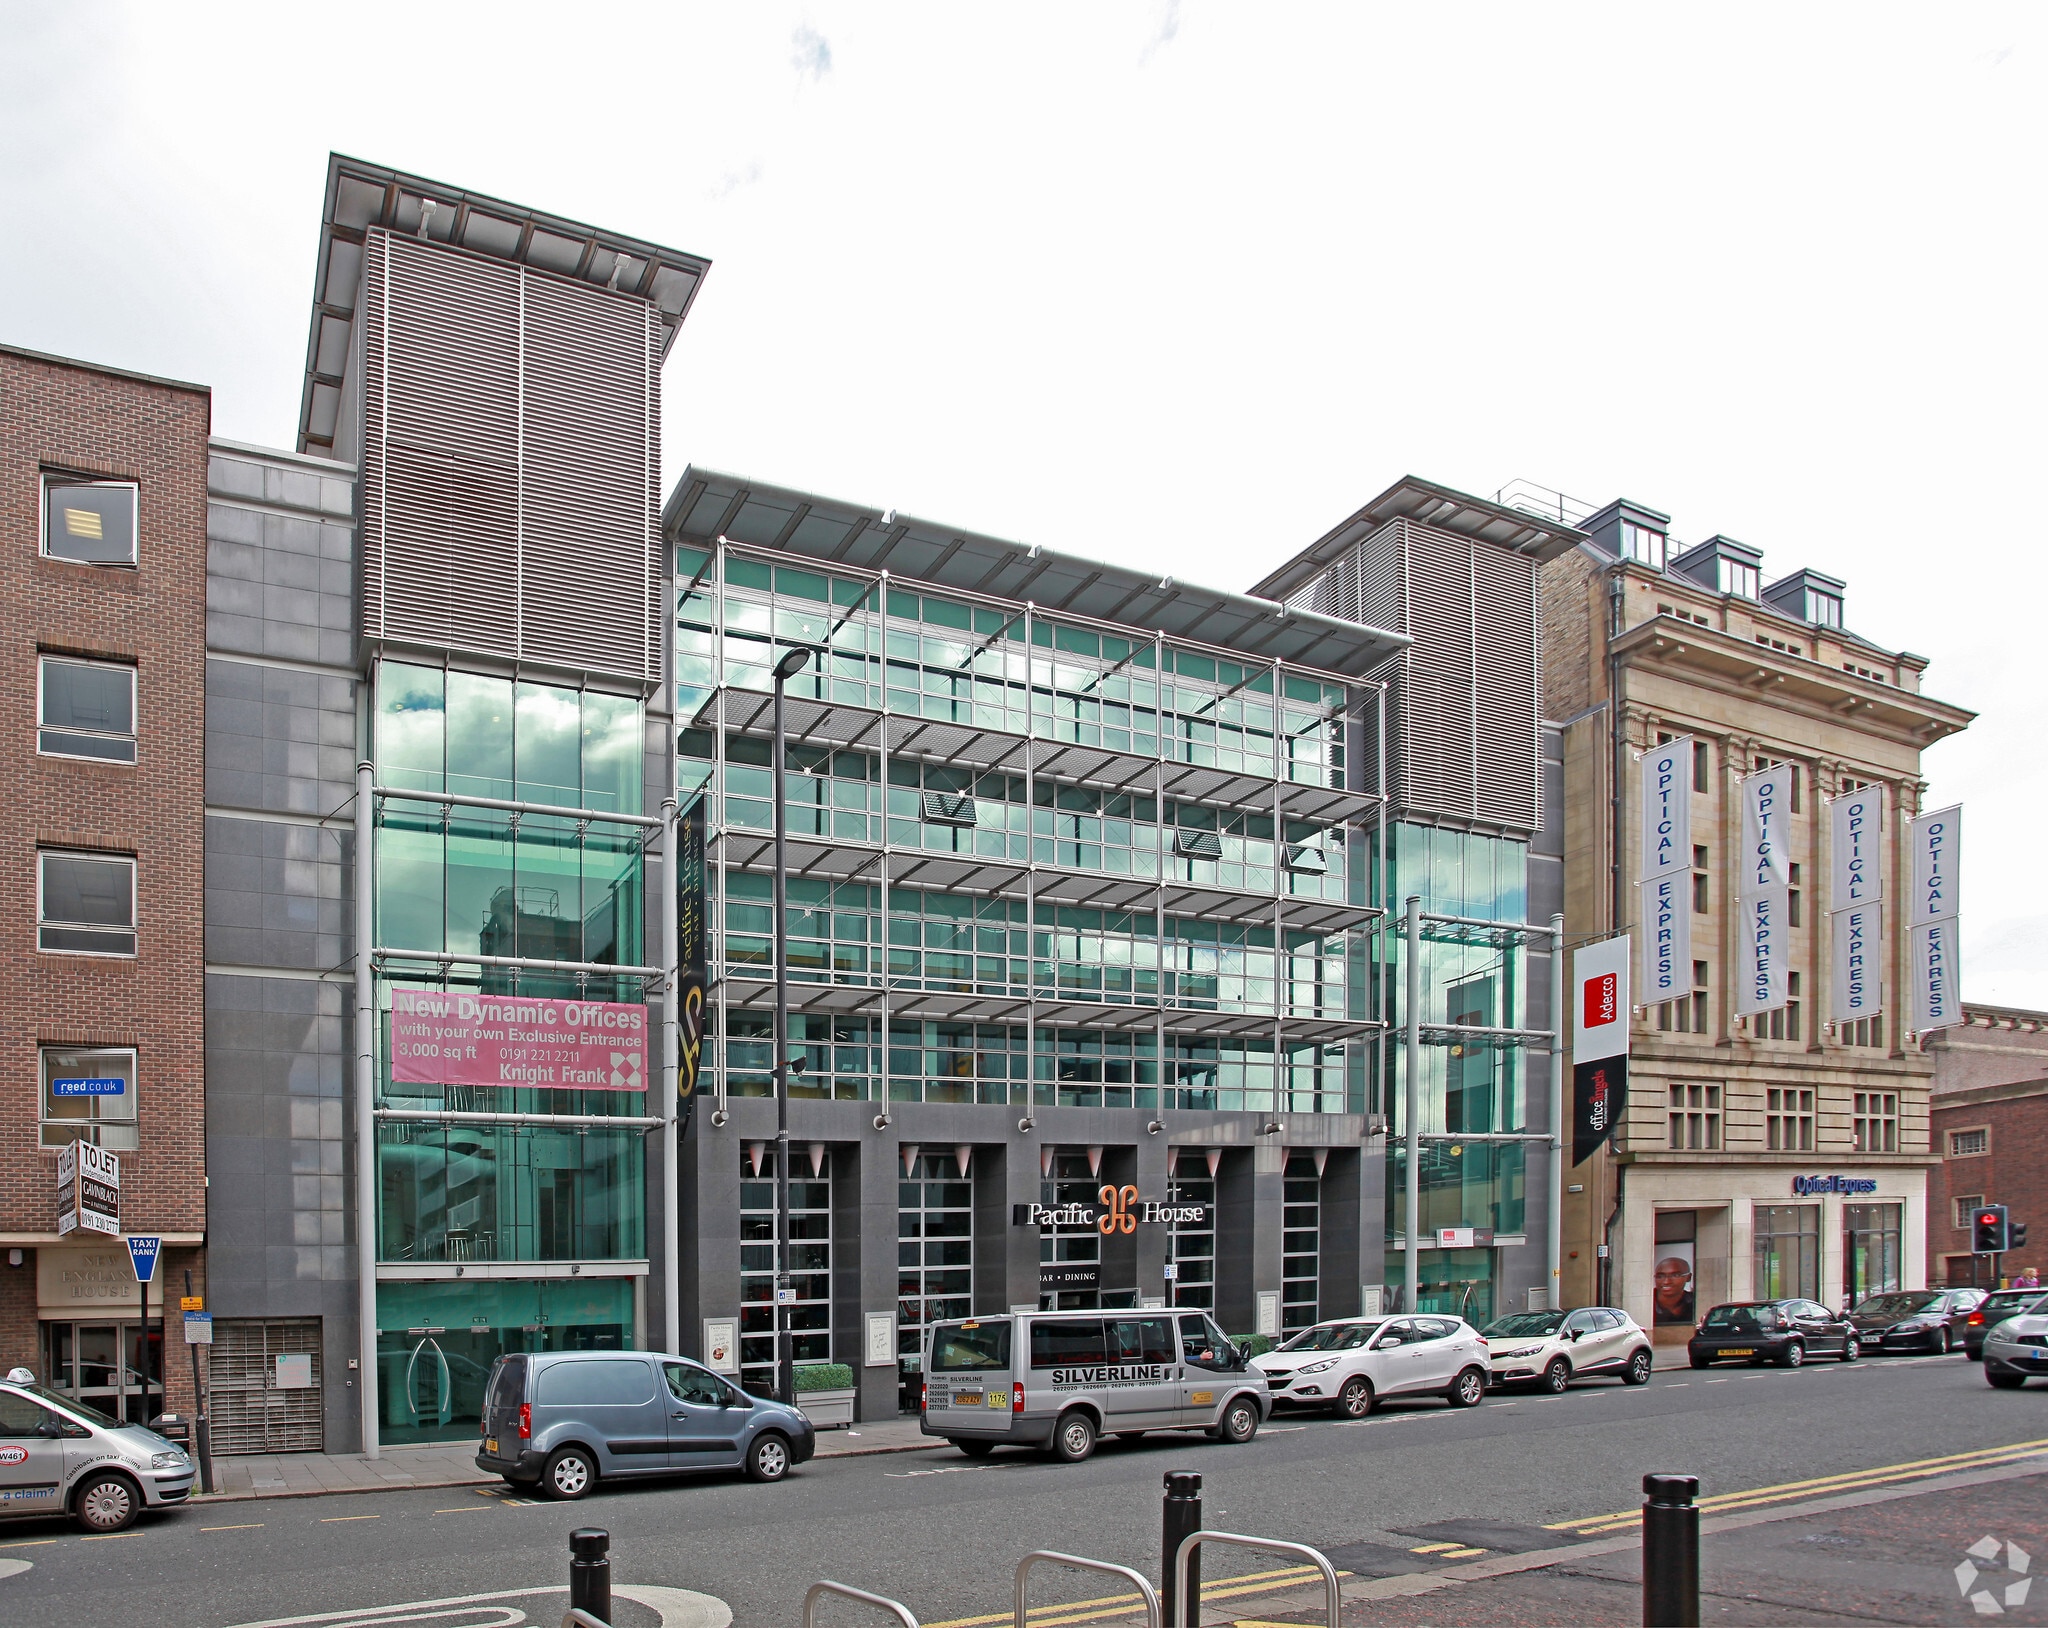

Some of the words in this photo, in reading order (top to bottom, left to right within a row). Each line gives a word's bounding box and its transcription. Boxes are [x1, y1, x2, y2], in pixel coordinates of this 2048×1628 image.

[1658, 758, 1672, 866] OPTICAL
[1757, 783, 1773, 885] OPTICAL
[682, 815, 692, 898] House
[1848, 804, 1863, 899] OPTICAL
[1927, 823, 1943, 914] OPTICAL
[682, 898, 692, 979] Pacific
[1658, 881, 1671, 988] EXPRESS
[1756, 900, 1770, 1001] EXPRESS
[1849, 913, 1863, 1008] EXPRESS
[1928, 928, 1943, 1017] EXPRESS
[1600, 977, 1614, 1020] Adecco
[399, 994, 450, 1019] New
[458, 998, 557, 1028] Dynamic
[564, 1004, 642, 1030] Offices
[399, 1022, 431, 1037] with
[435, 1026, 470, 1041] your
[473, 1028, 504, 1041] own
[508, 1028, 576, 1044] Exclusive
[580, 1032, 642, 1047] Entrance
[399, 1042, 439, 1059] 3,000
[443, 1048, 461, 1061] sq
[465, 1046, 477, 1059] ft
[500, 1047, 526, 1060] 0191
[531, 1049, 551, 1062] 221
[554, 1050, 580, 1063] 2211
[61, 1081, 116, 1093] reed.co.uk
[500, 1063, 554, 1086] Knight
[562, 1066, 607, 1085] Frank
[1589, 1100, 1604, 1131] office
[83, 1144, 97, 1168] TO
[100, 1151, 116, 1177] LET
[1795, 1175, 1834, 1193] Optical
[1837, 1177, 1876, 1194] Express
[1027, 1202, 1094, 1225] Pacific
[1142, 1202, 1204, 1223] House
[132, 1239, 156, 1248] TAXI
[83, 1255, 120, 1266] NEW
[1064, 1273, 1096, 1281] DINING
[71, 1286, 131, 1297] HOUSE
[1052, 1365, 1161, 1384] SILVERLINE
[989, 1394, 1006, 1402] 1175
[66, 1457, 94, 1480] cashback
[120, 1456, 141, 1470] claims
[3, 1492, 11, 1500] a
[15, 1487, 55, 1499] claim?
